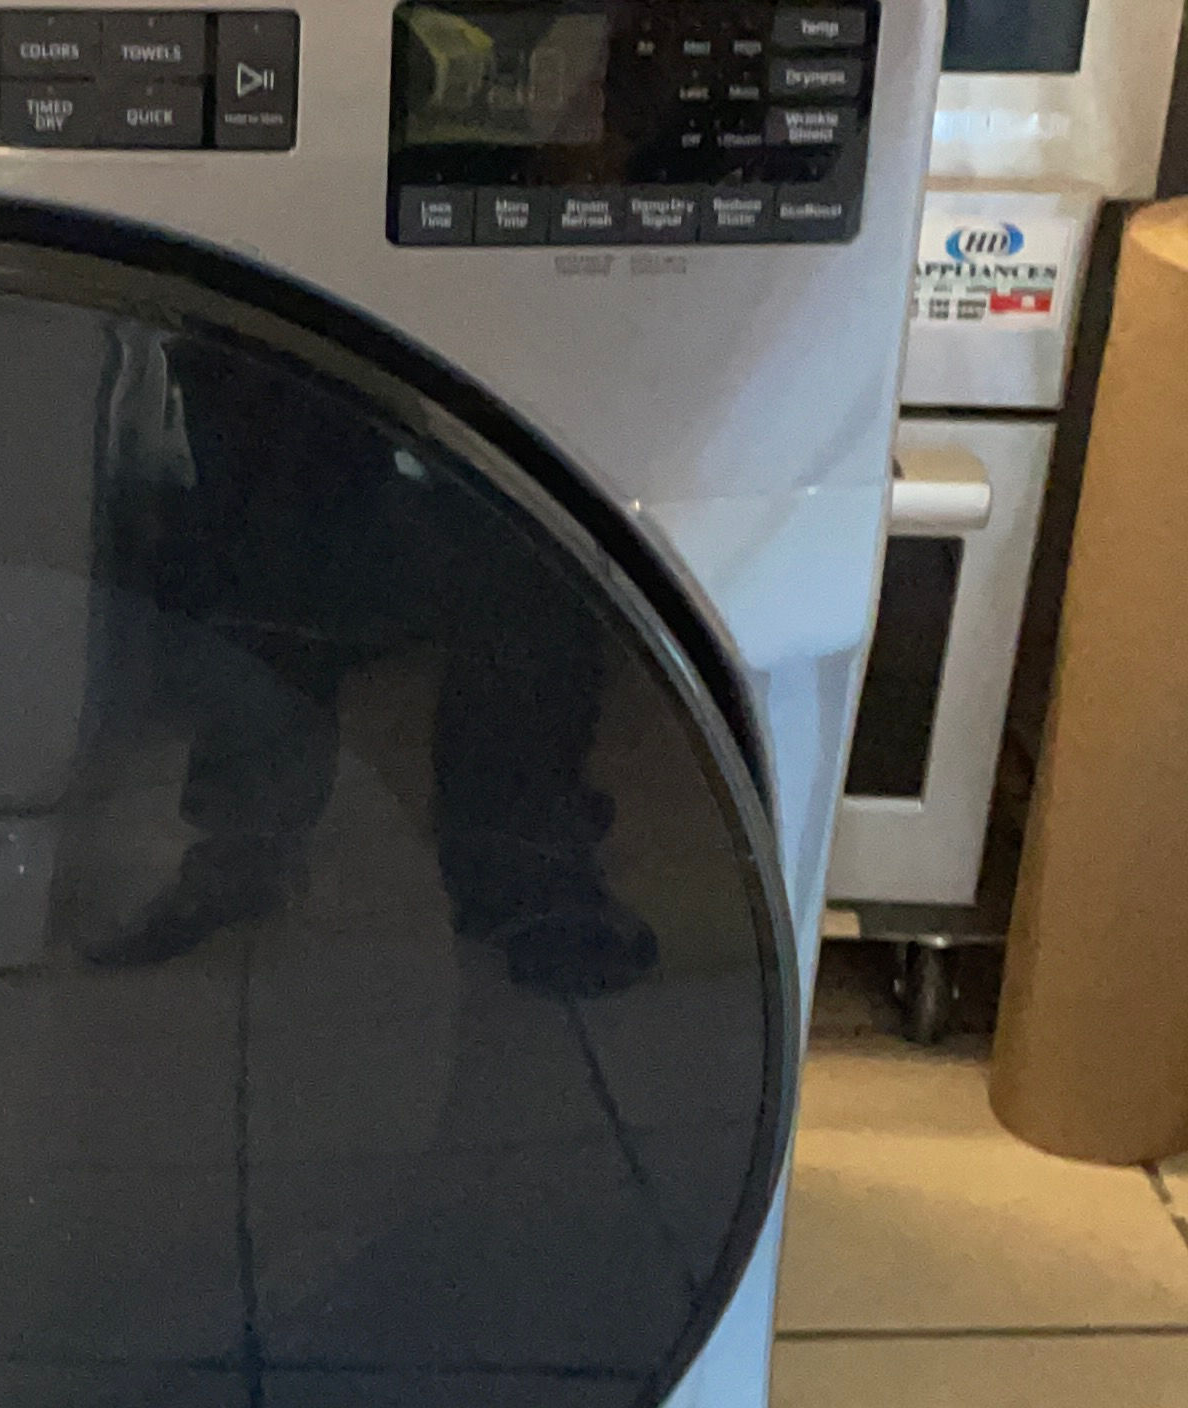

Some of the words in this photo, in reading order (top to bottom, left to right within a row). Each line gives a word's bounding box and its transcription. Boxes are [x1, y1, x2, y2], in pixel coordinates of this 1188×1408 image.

[801, 19, 839, 37] Temp
[20, 43, 80, 60] COLORS
[122, 45, 181, 62] TOWELS
[785, 68, 846, 88] Dryness
[27, 99, 73, 116] TIMED
[35, 115, 65, 132] DRY
[126, 108, 174, 127] QUICK
[785, 111, 839, 126] Wrinkle
[495, 198, 529, 212] More
[421, 215, 452, 229] Time
[497, 213, 529, 228] Time
[965, 231, 1010, 254] HD
